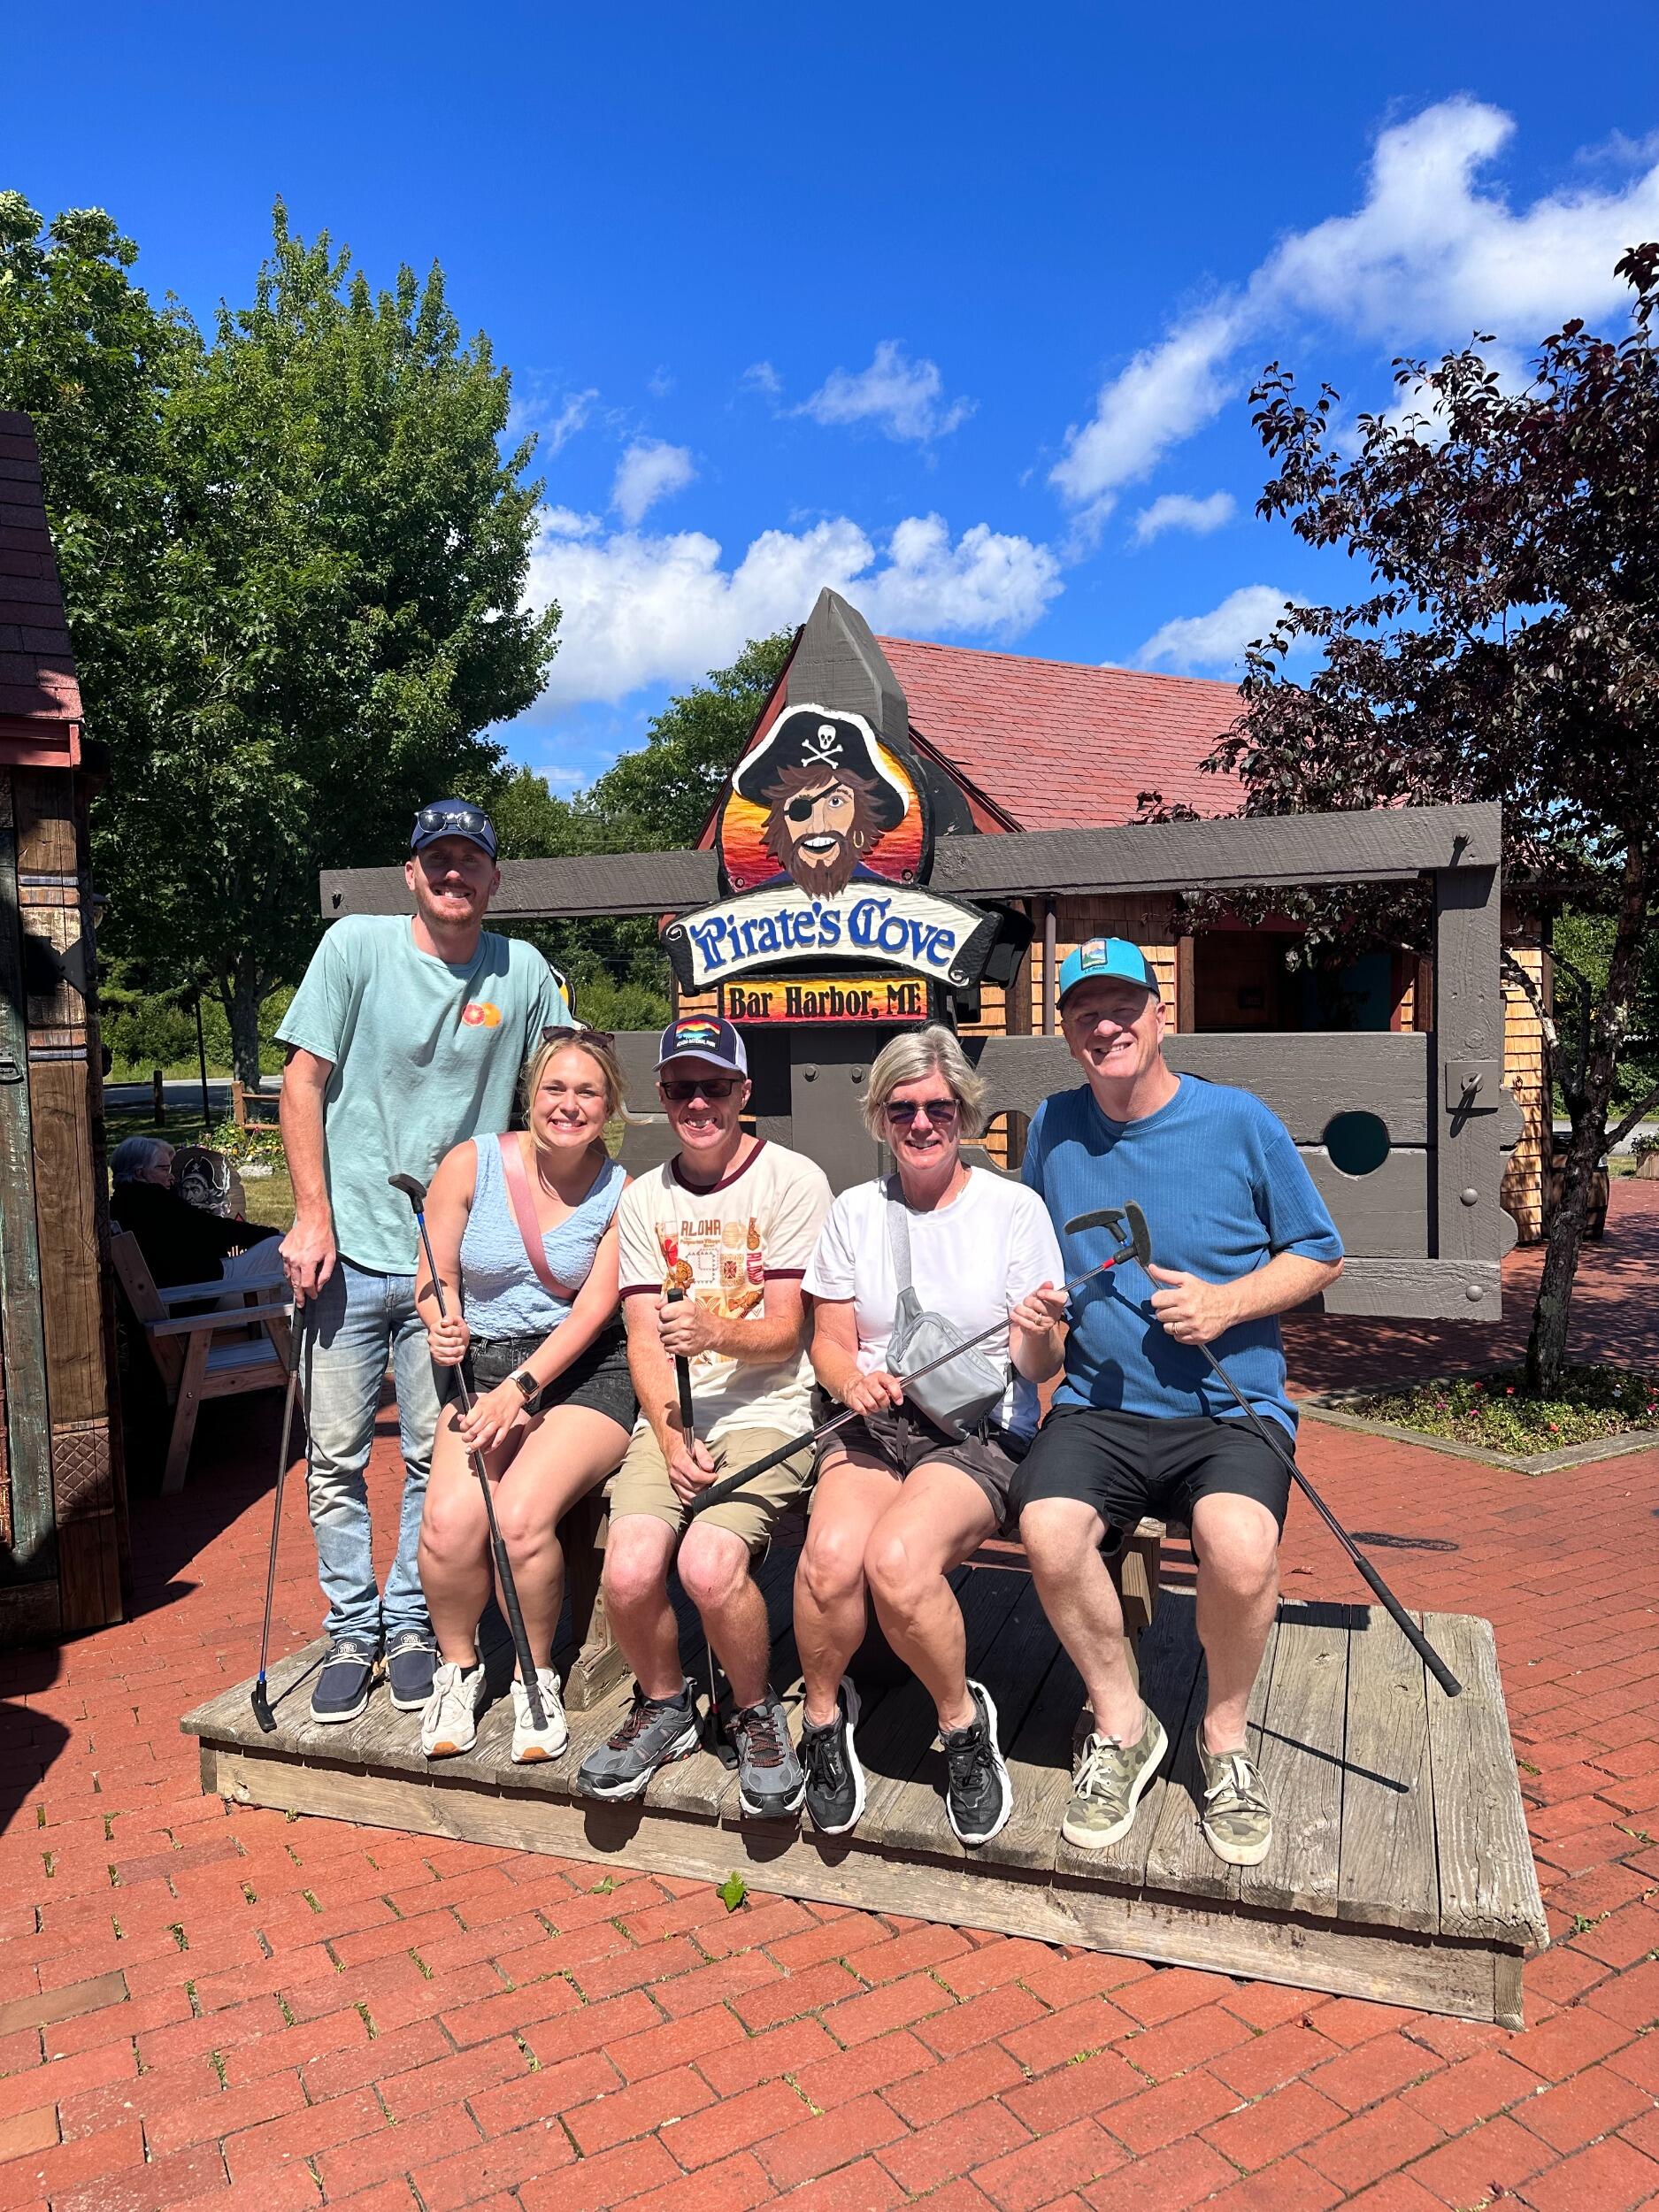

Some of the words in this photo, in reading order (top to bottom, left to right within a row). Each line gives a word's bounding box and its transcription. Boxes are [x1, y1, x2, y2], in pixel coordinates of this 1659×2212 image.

[691, 901, 841, 972] Pirate's
[848, 897, 956, 966] Cove
[729, 987, 772, 1019] Bar
[786, 987, 879, 1019] Harbor,
[887, 984, 921, 1017] ME
[680, 1219, 721, 1236] ALOHA
